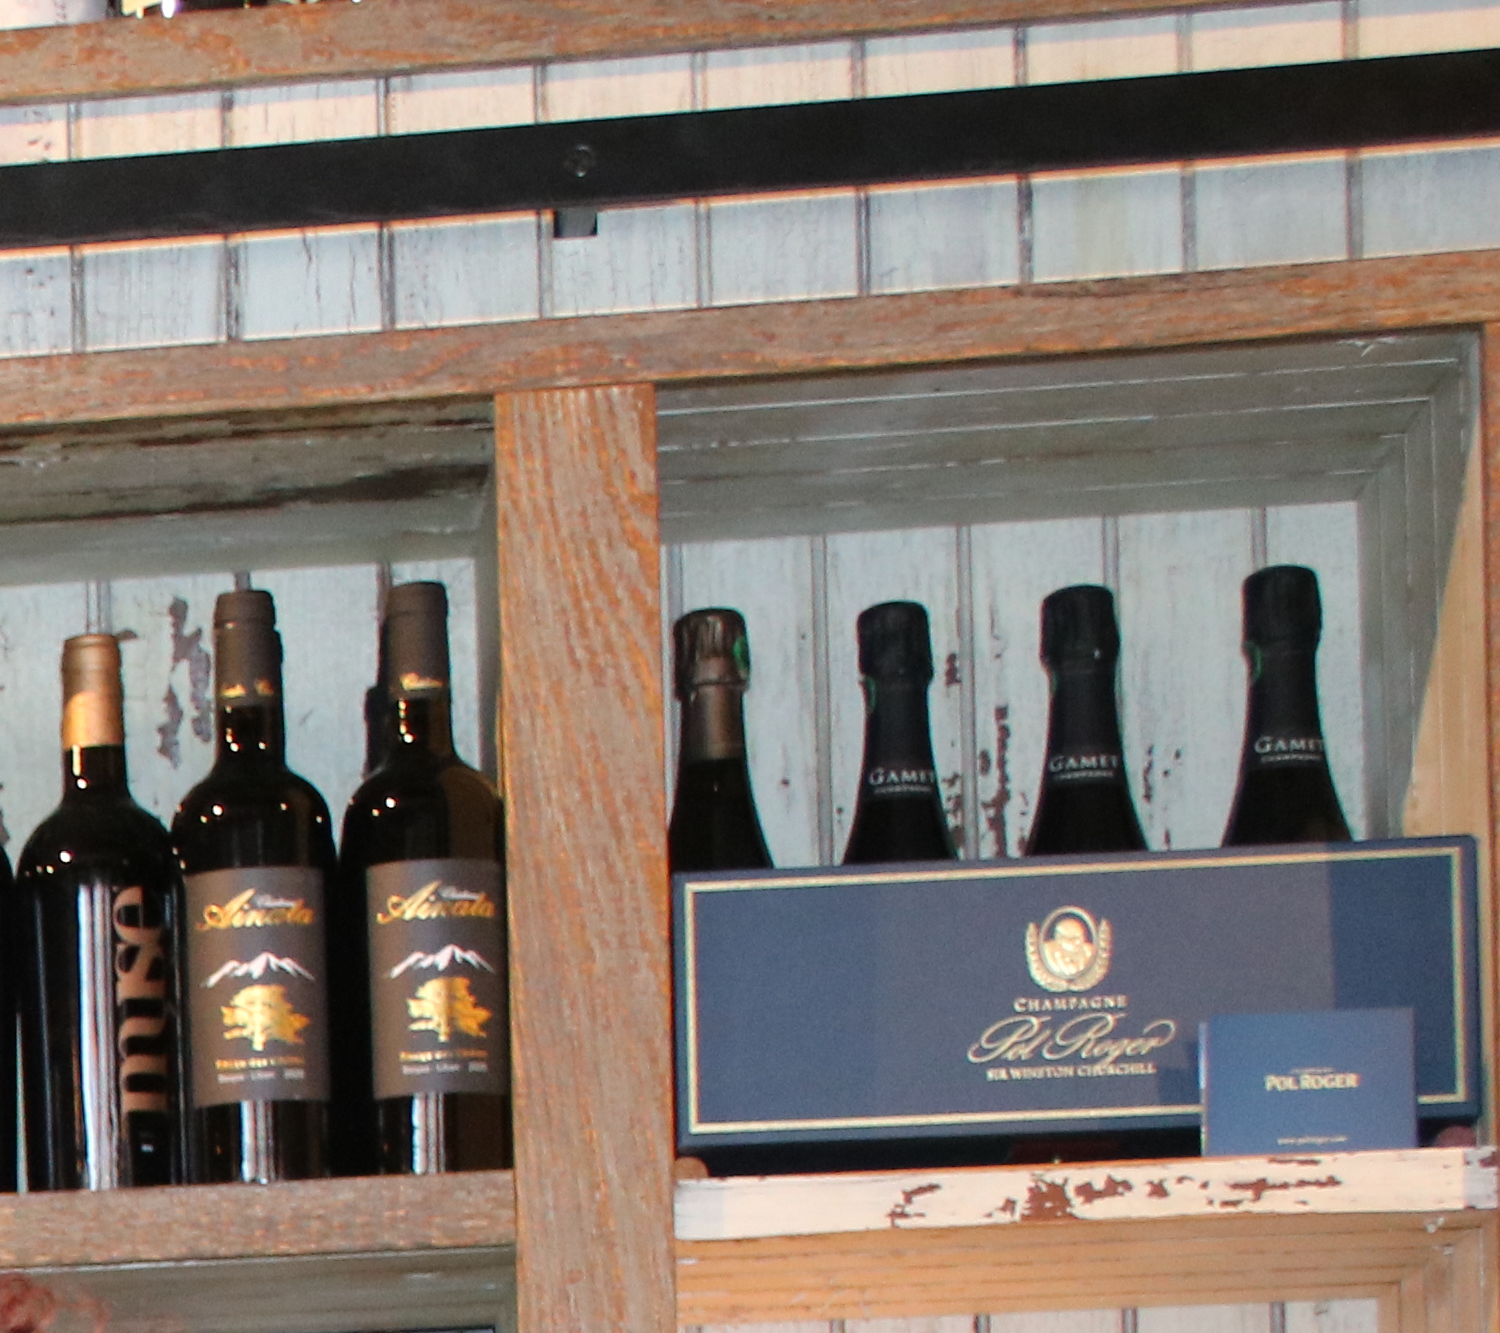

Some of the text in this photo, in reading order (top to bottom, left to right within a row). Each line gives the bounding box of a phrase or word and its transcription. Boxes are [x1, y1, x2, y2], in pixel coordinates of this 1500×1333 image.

[1012, 994, 1128, 1013] CHAMPAGNE
[966, 1011, 1178, 1065] Pol Roger
[985, 1062, 1157, 1082] SIR WINSTON CHURCHILL
[1265, 1072, 1361, 1092] POL ROGER
